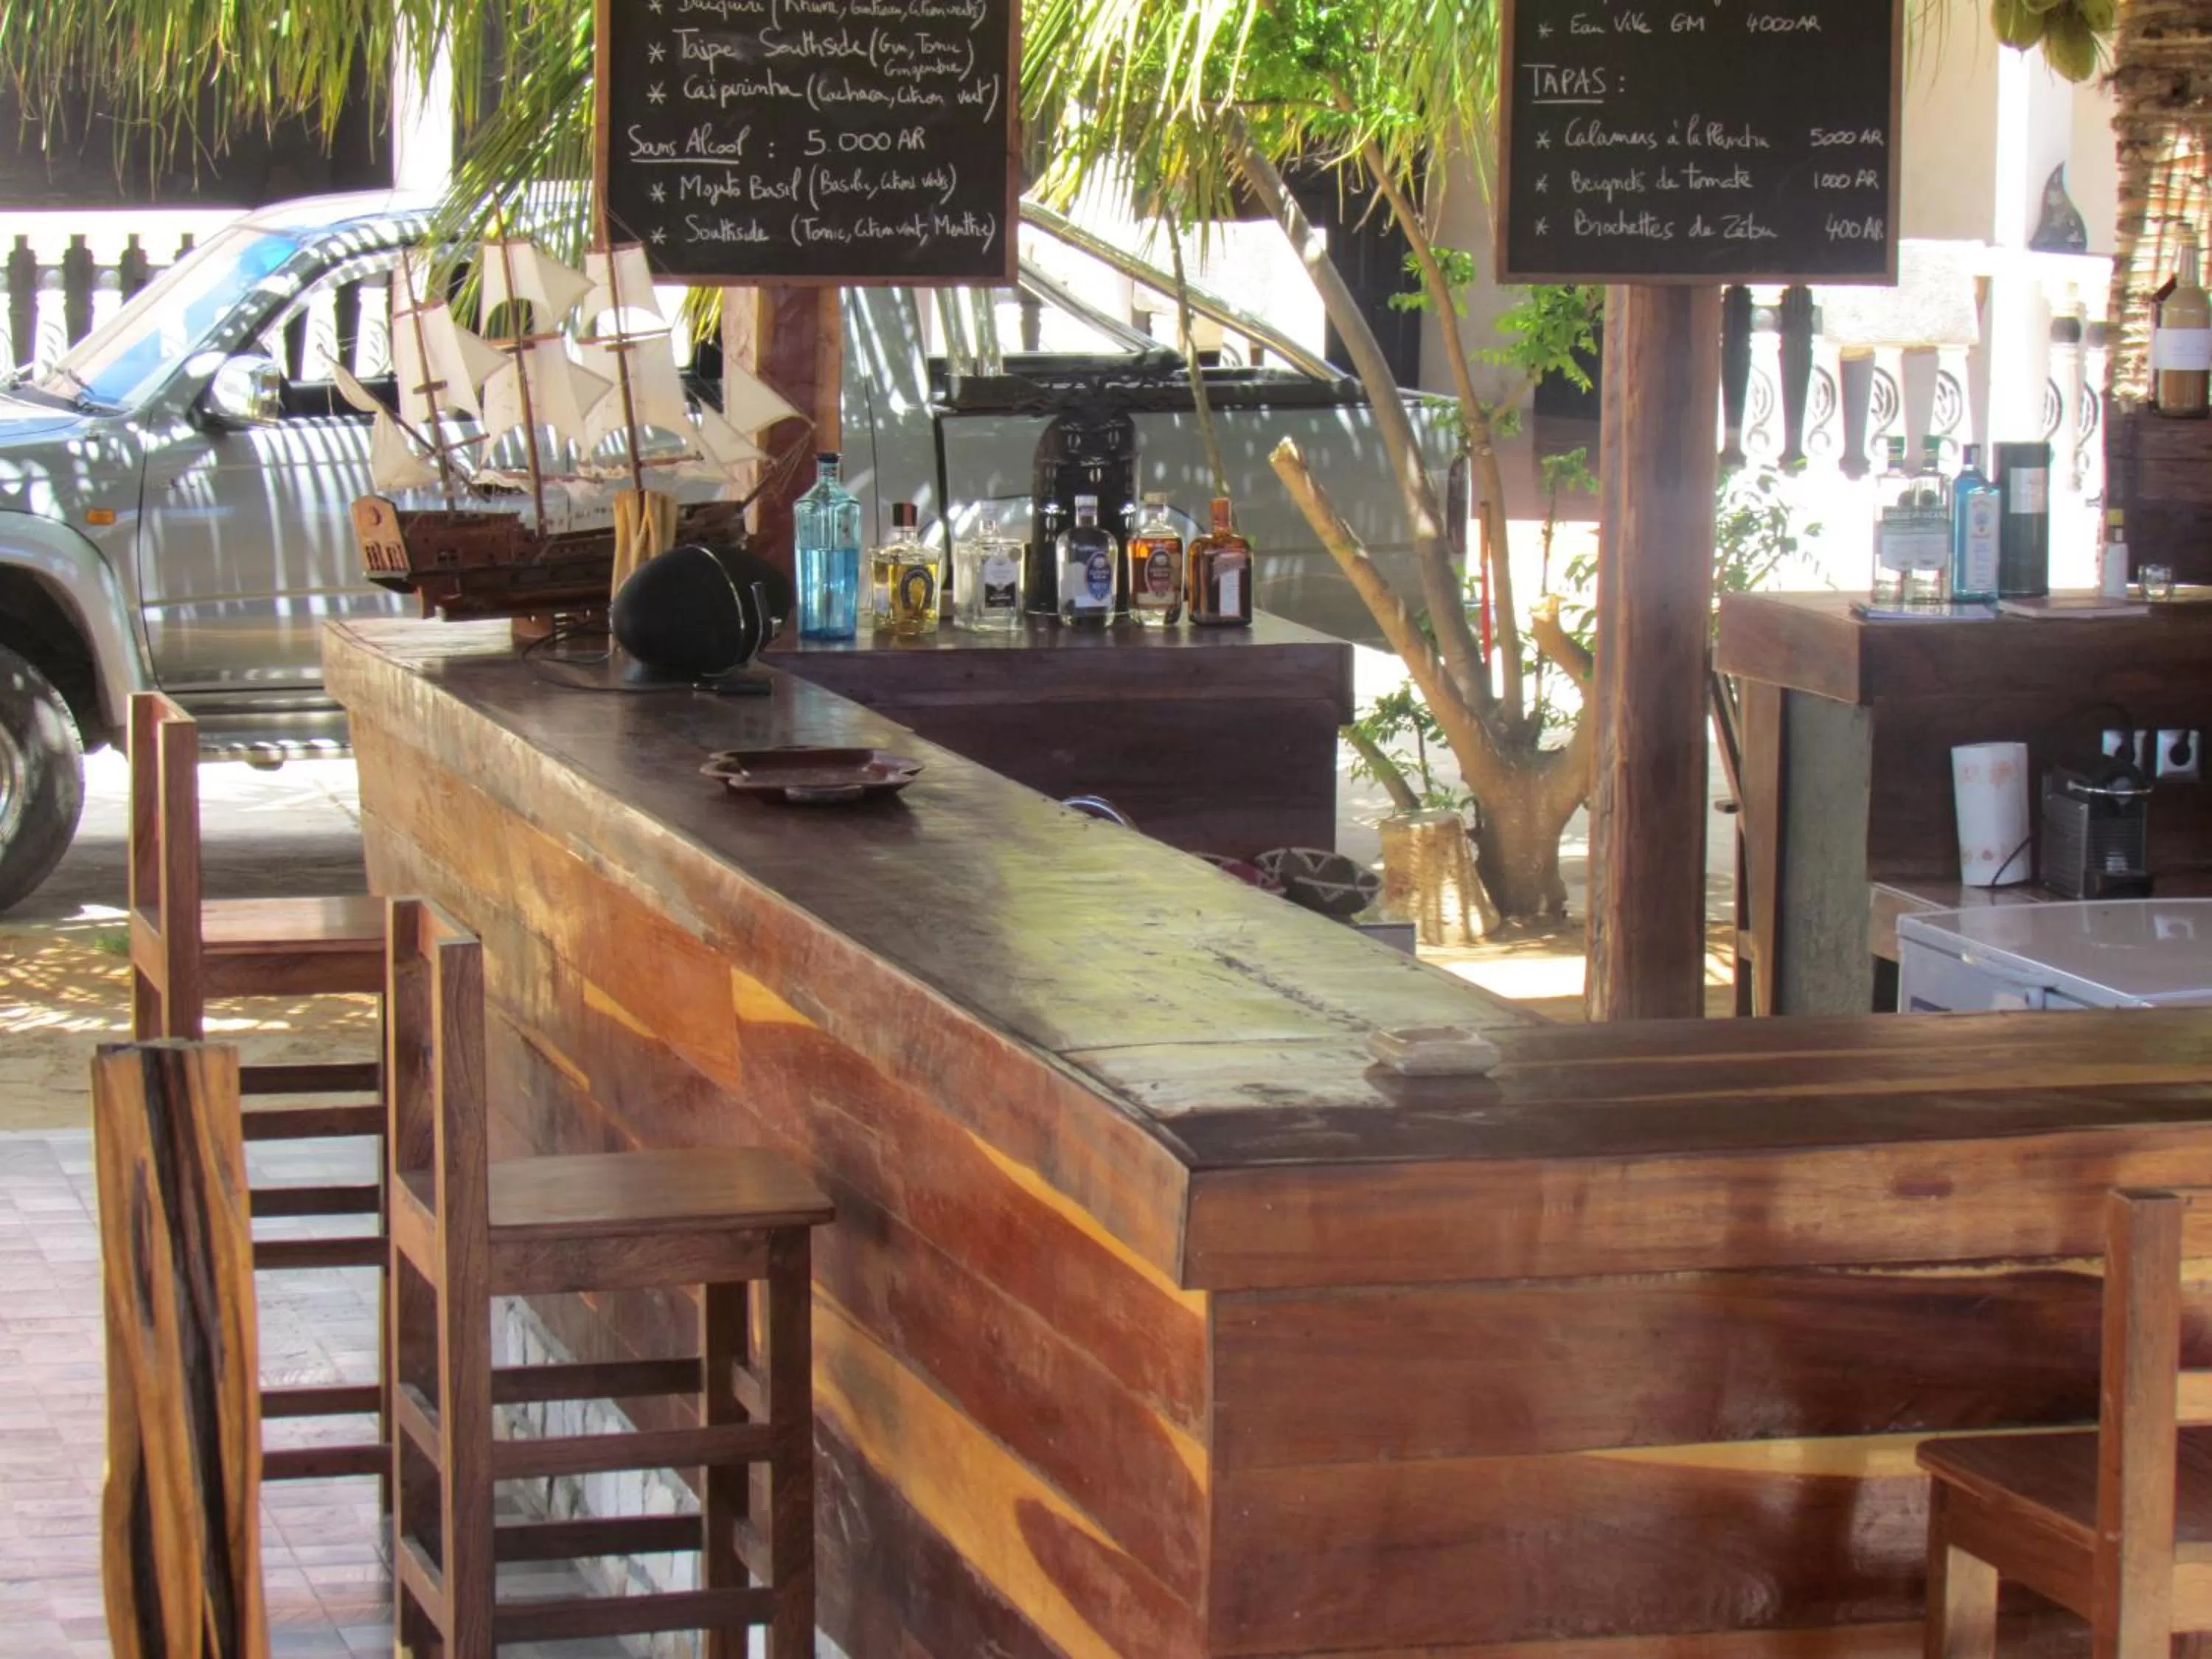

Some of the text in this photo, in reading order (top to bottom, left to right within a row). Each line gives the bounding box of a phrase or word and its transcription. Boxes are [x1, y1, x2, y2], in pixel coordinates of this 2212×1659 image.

[1570, 12, 1605, 35] Eau
[1670, 12, 1705, 33] GM
[759, 27, 867, 58] Southside
[869, 27, 914, 68] (Gin,
[627, 124, 677, 157] Sans
[685, 122, 751, 157] Alcool
[897, 126, 926, 150] AR
[1810, 128, 1856, 147] 5000
[1860, 129, 1885, 147] AR
[750, 167, 802, 201] Basil
[1656, 165, 1680, 189] de
[1680, 161, 1754, 189] tomate
[1855, 169, 1879, 189] AR
[685, 215, 770, 243] Southside
[1574, 209, 1674, 241] Brochettes
[1863, 216, 1885, 241] AR
